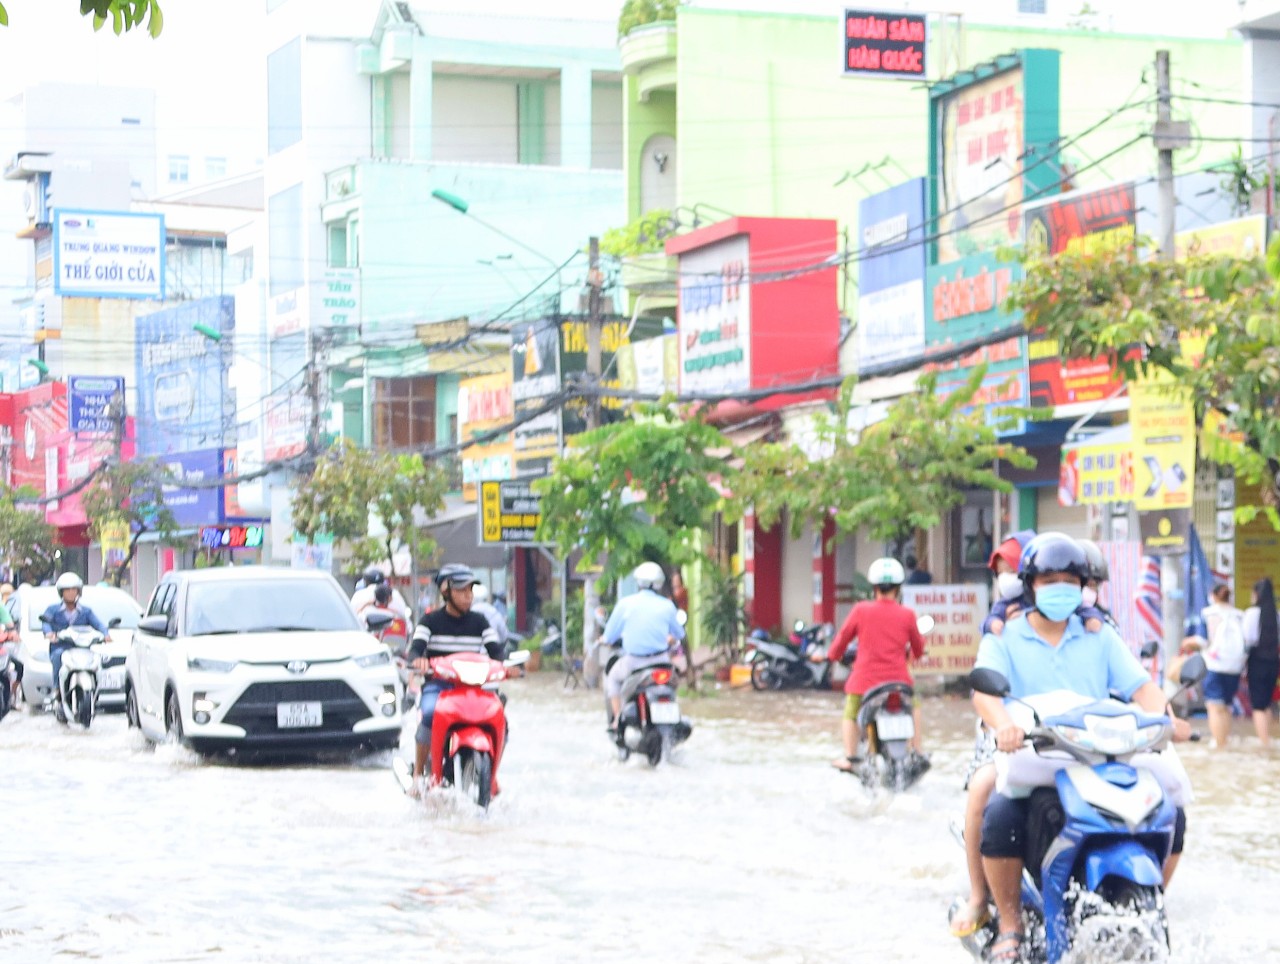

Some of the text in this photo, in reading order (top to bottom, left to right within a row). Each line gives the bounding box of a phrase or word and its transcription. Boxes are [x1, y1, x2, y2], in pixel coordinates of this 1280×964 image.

[847, 16, 925, 42] NHÂN SÂM
[849, 45, 923, 72] HÀN QUỐC
[64, 242, 90, 253] TRUNG
[123, 244, 156, 255] WINDOW
[64, 257, 156, 282] THẾ GIỚI CỬA
